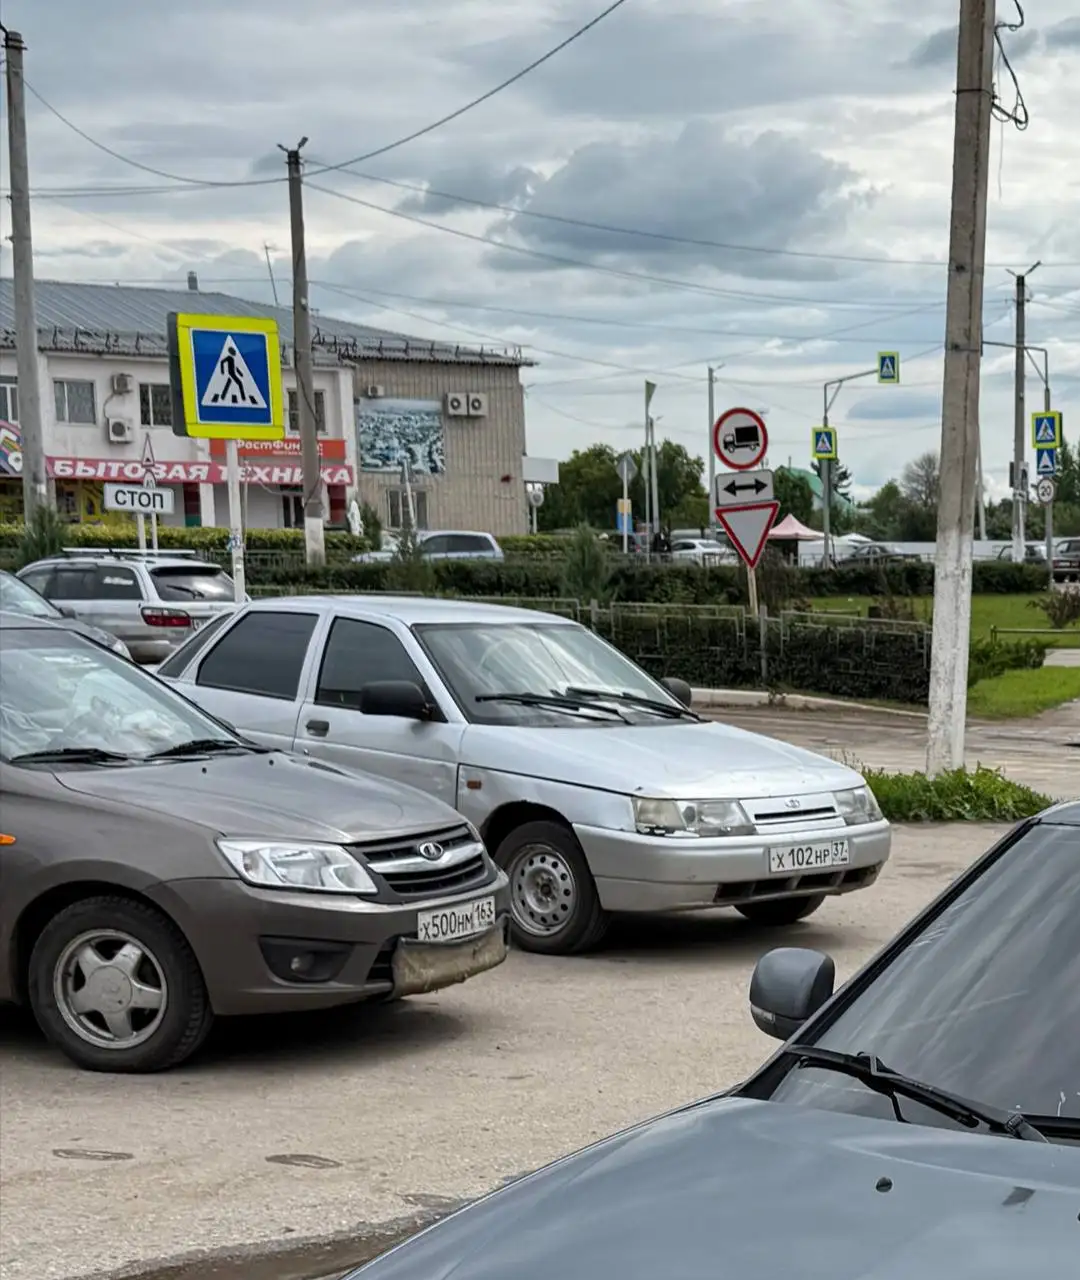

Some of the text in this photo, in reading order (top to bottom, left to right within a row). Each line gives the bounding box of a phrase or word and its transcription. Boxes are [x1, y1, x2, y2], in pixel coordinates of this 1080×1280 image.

[53, 459, 209, 481] БЫТОВАЯ
[114, 489, 164, 509] СТОП
[1040, 485, 1052, 497] 20
[833, 841, 845, 857] 37
[475, 901, 493, 921] 163
